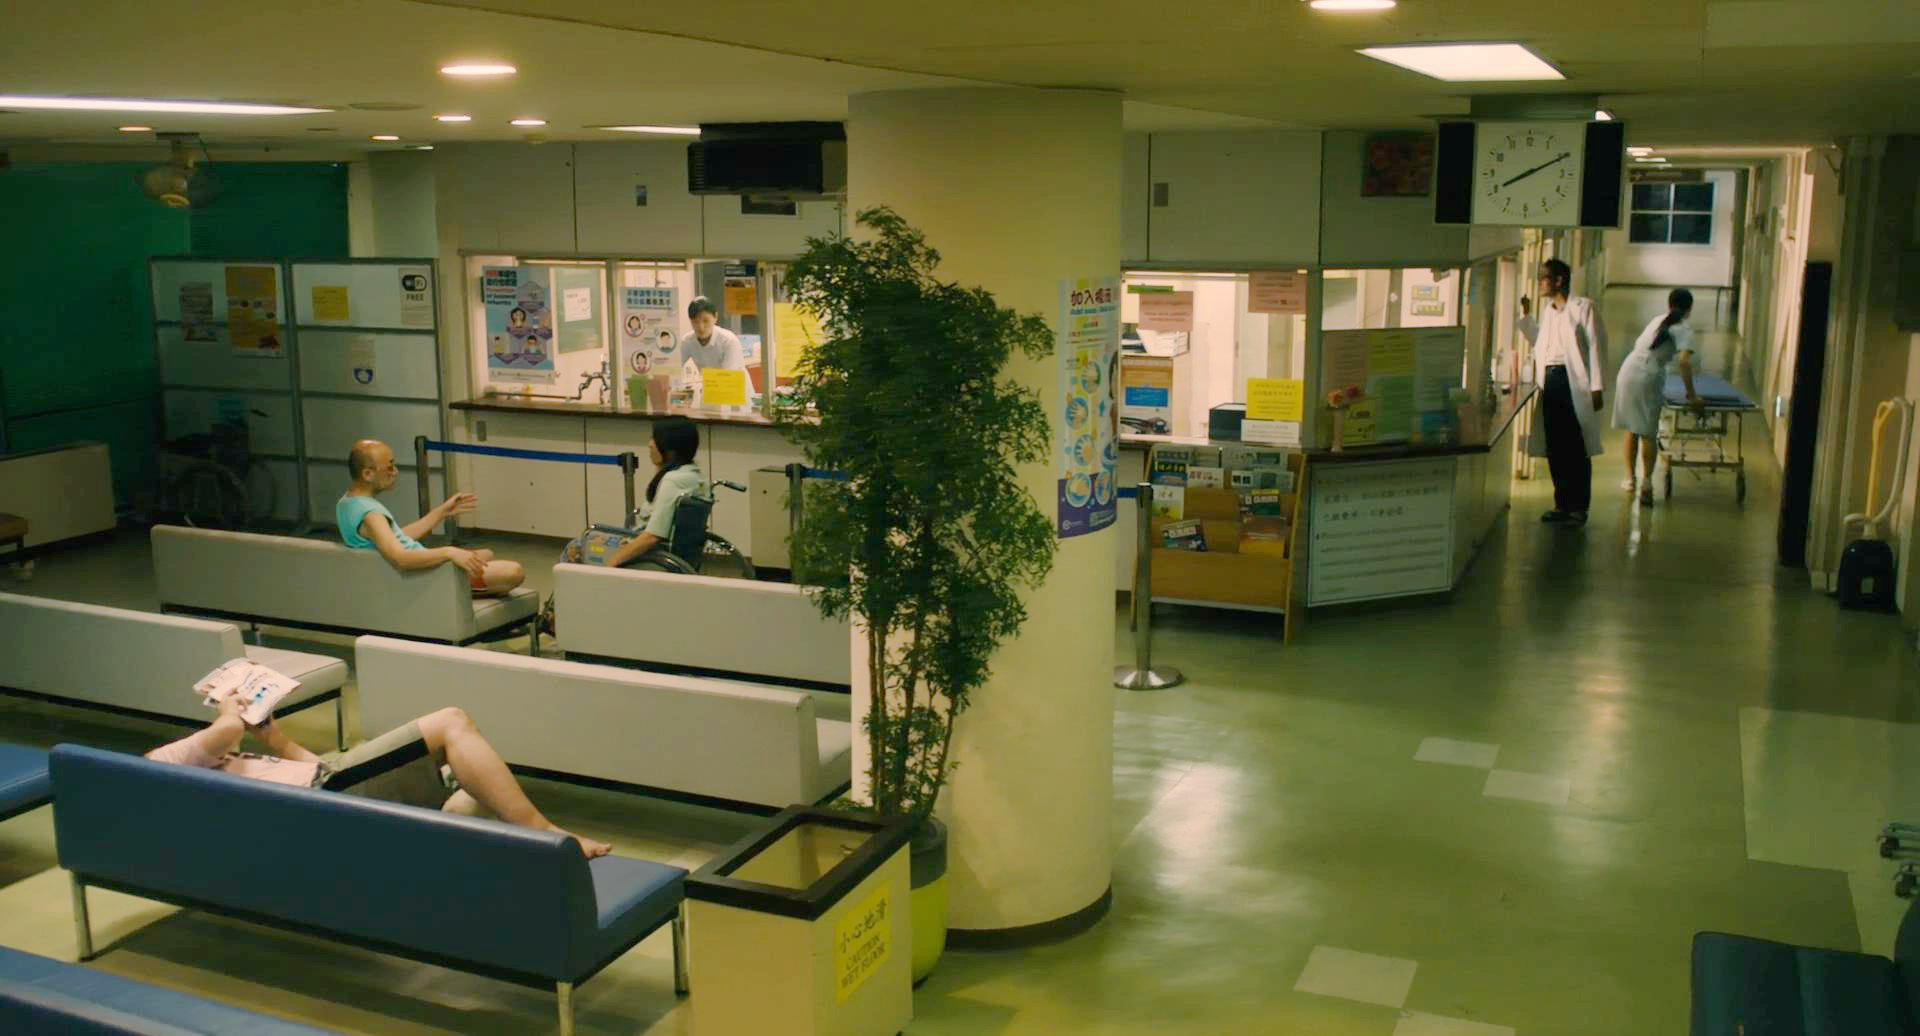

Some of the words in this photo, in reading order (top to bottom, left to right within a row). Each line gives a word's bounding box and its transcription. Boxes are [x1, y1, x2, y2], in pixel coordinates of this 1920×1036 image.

[1526, 137, 1534, 147] 12
[1496, 152, 1504, 162] 10
[406, 293, 424, 301] FREE
